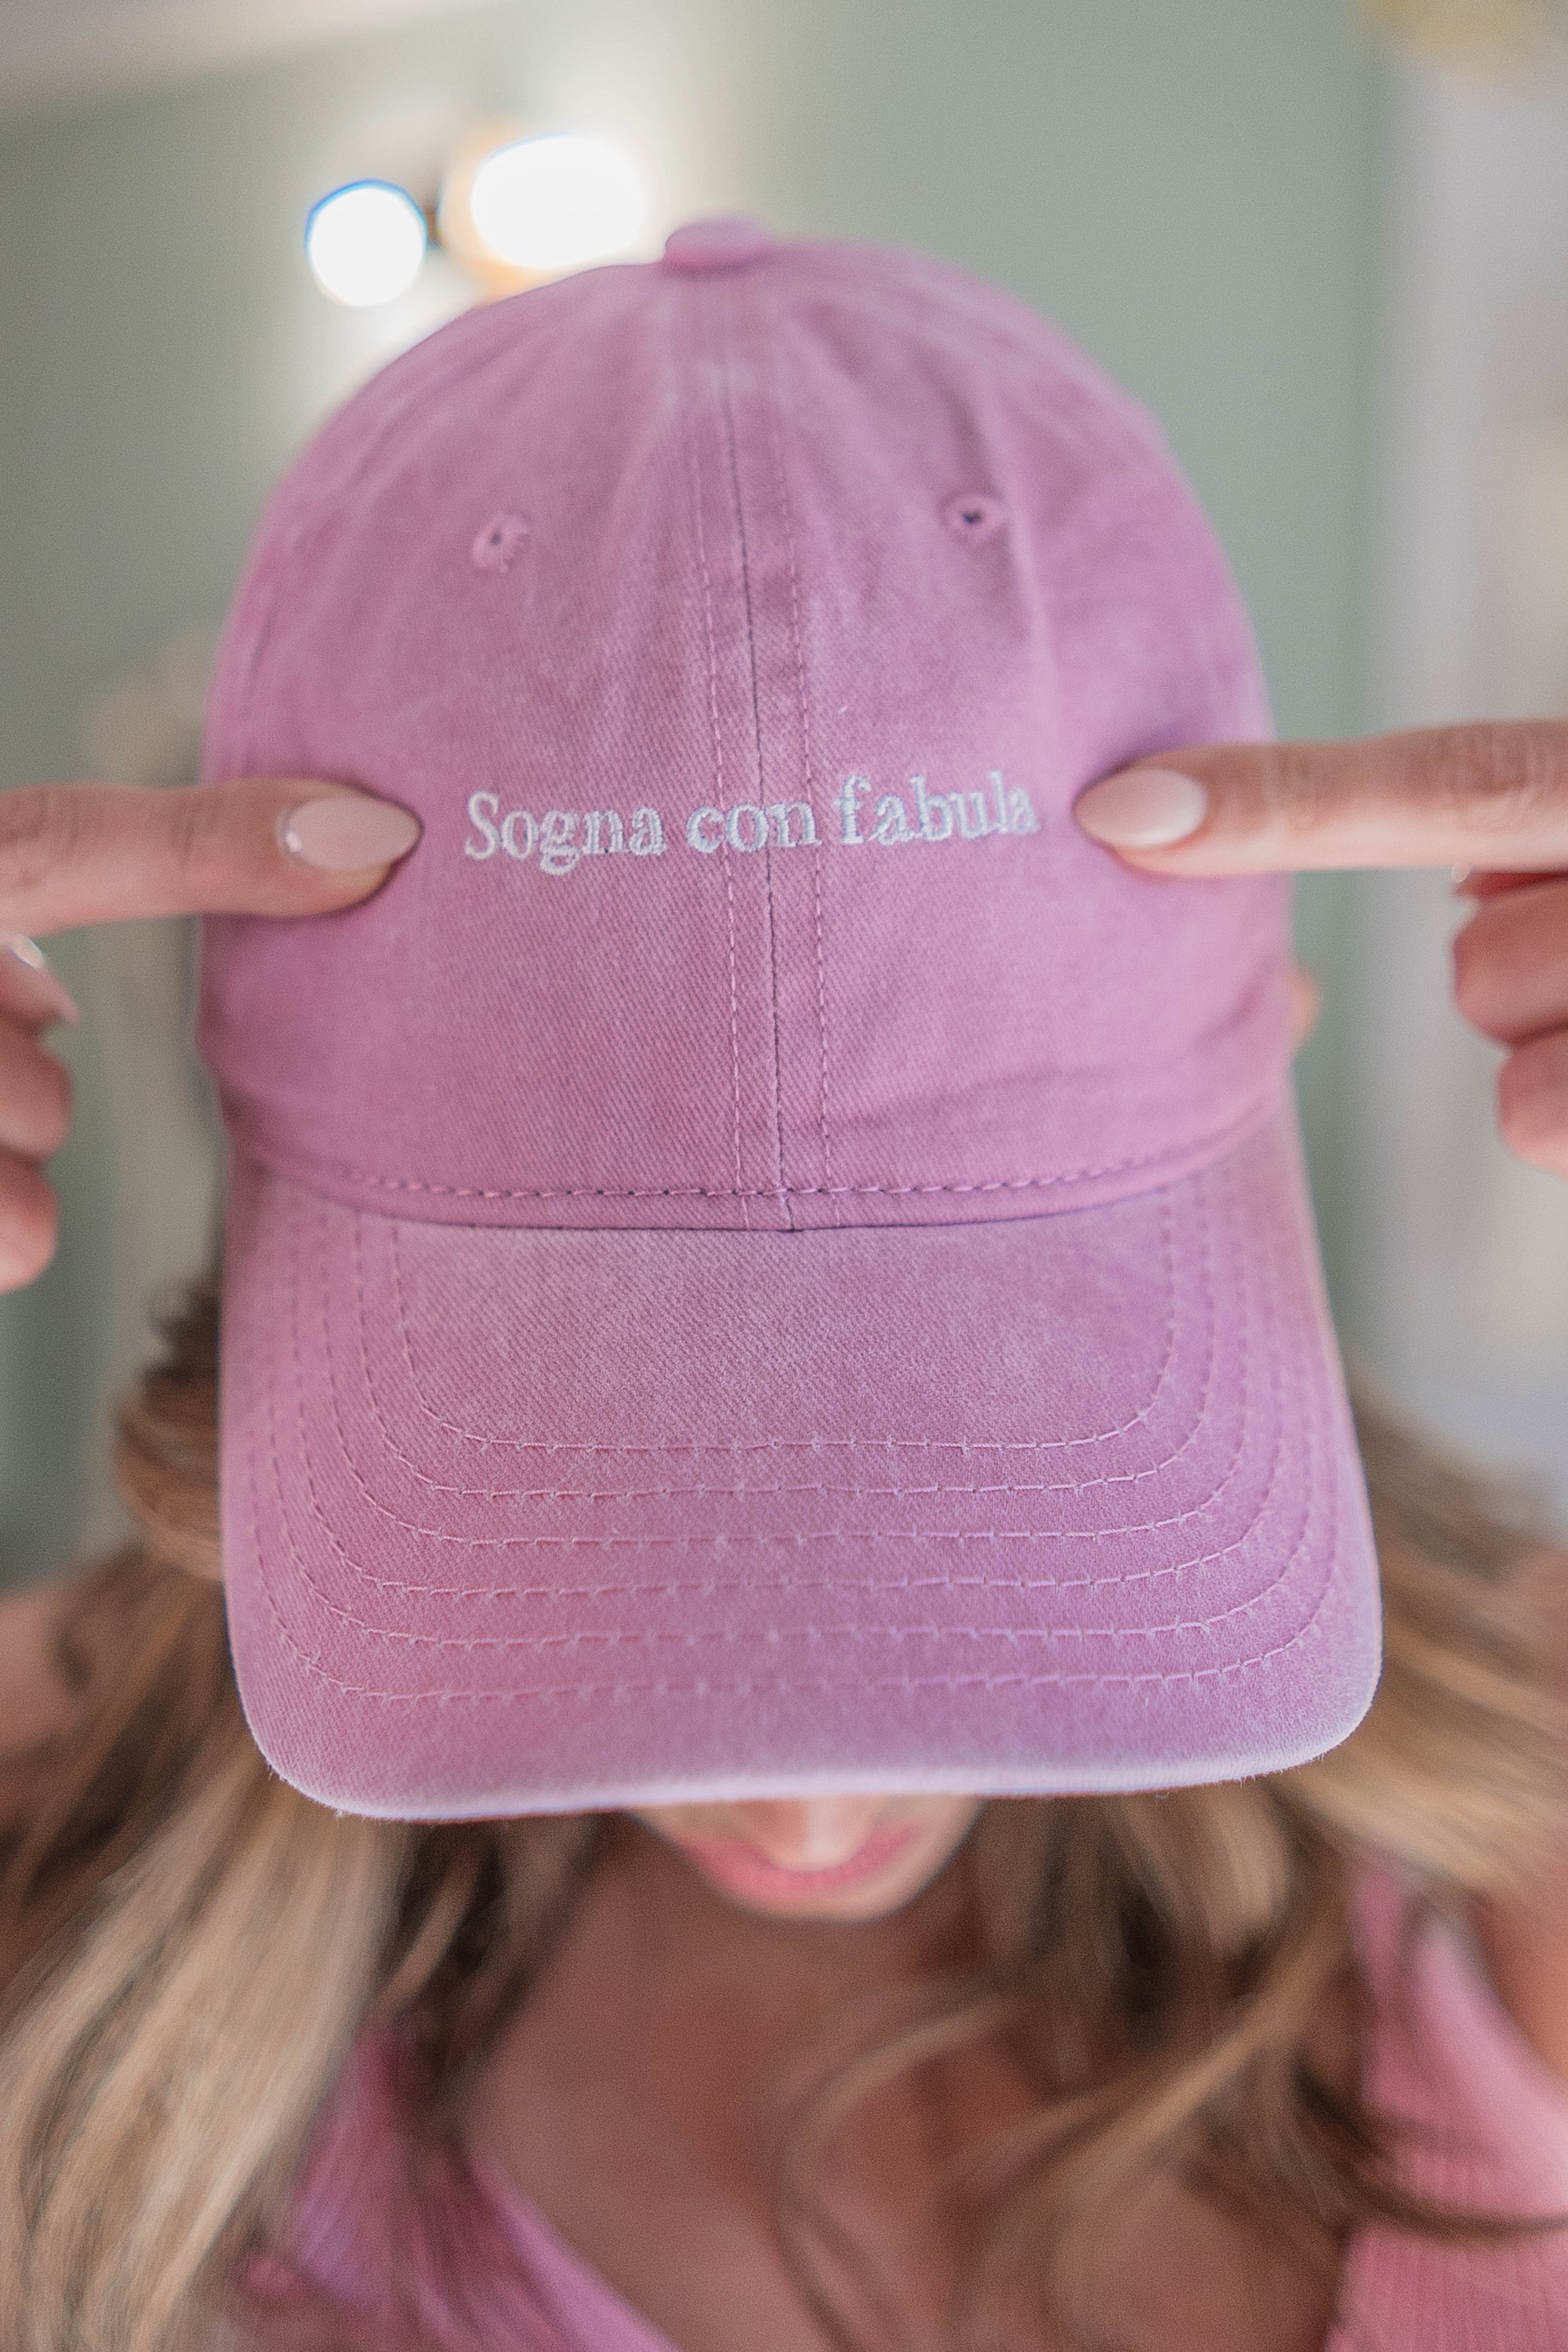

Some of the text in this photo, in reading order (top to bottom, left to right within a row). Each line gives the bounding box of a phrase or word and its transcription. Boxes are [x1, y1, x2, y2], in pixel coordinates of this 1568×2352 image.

[464, 769, 1041, 877] Sogna con fabula
